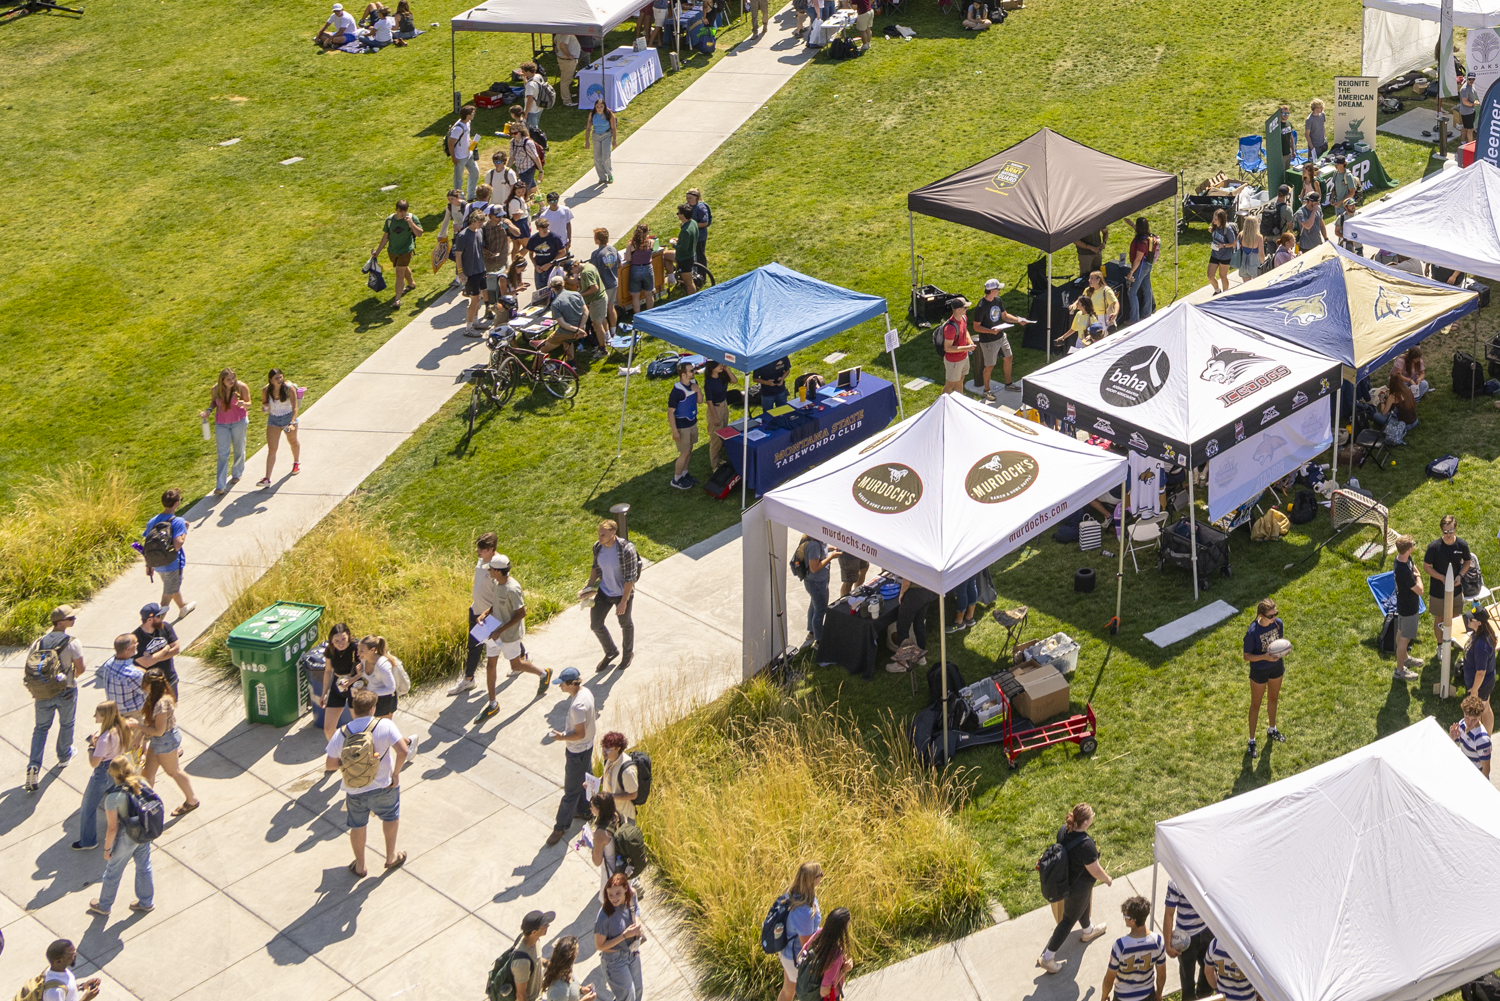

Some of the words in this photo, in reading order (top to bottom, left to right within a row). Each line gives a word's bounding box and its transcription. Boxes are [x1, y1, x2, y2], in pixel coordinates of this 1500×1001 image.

[1338, 100, 1365, 108] DREAM.
[998, 174, 1017, 183] GUARD
[1004, 166, 1023, 175] ARMY
[1109, 368, 1148, 392] baha
[774, 428, 830, 464] MONTANA
[831, 408, 865, 435] STATE
[775, 434, 836, 469] TAEKWONDO
[838, 420, 863, 438] CLUB
[858, 475, 914, 506] MURDOCH'S
[972, 458, 1035, 499] MURDOCH'S
[990, 493, 1006, 501] RANCH
[1010, 485, 1021, 495] HOME
[1020, 474, 1032, 488] SUPPLY
[870, 502, 881, 510] HOME
[1008, 500, 1068, 544] murdochs.com
[822, 525, 878, 558] murdochs.com
[257, 684, 267, 712] RECYCLE
